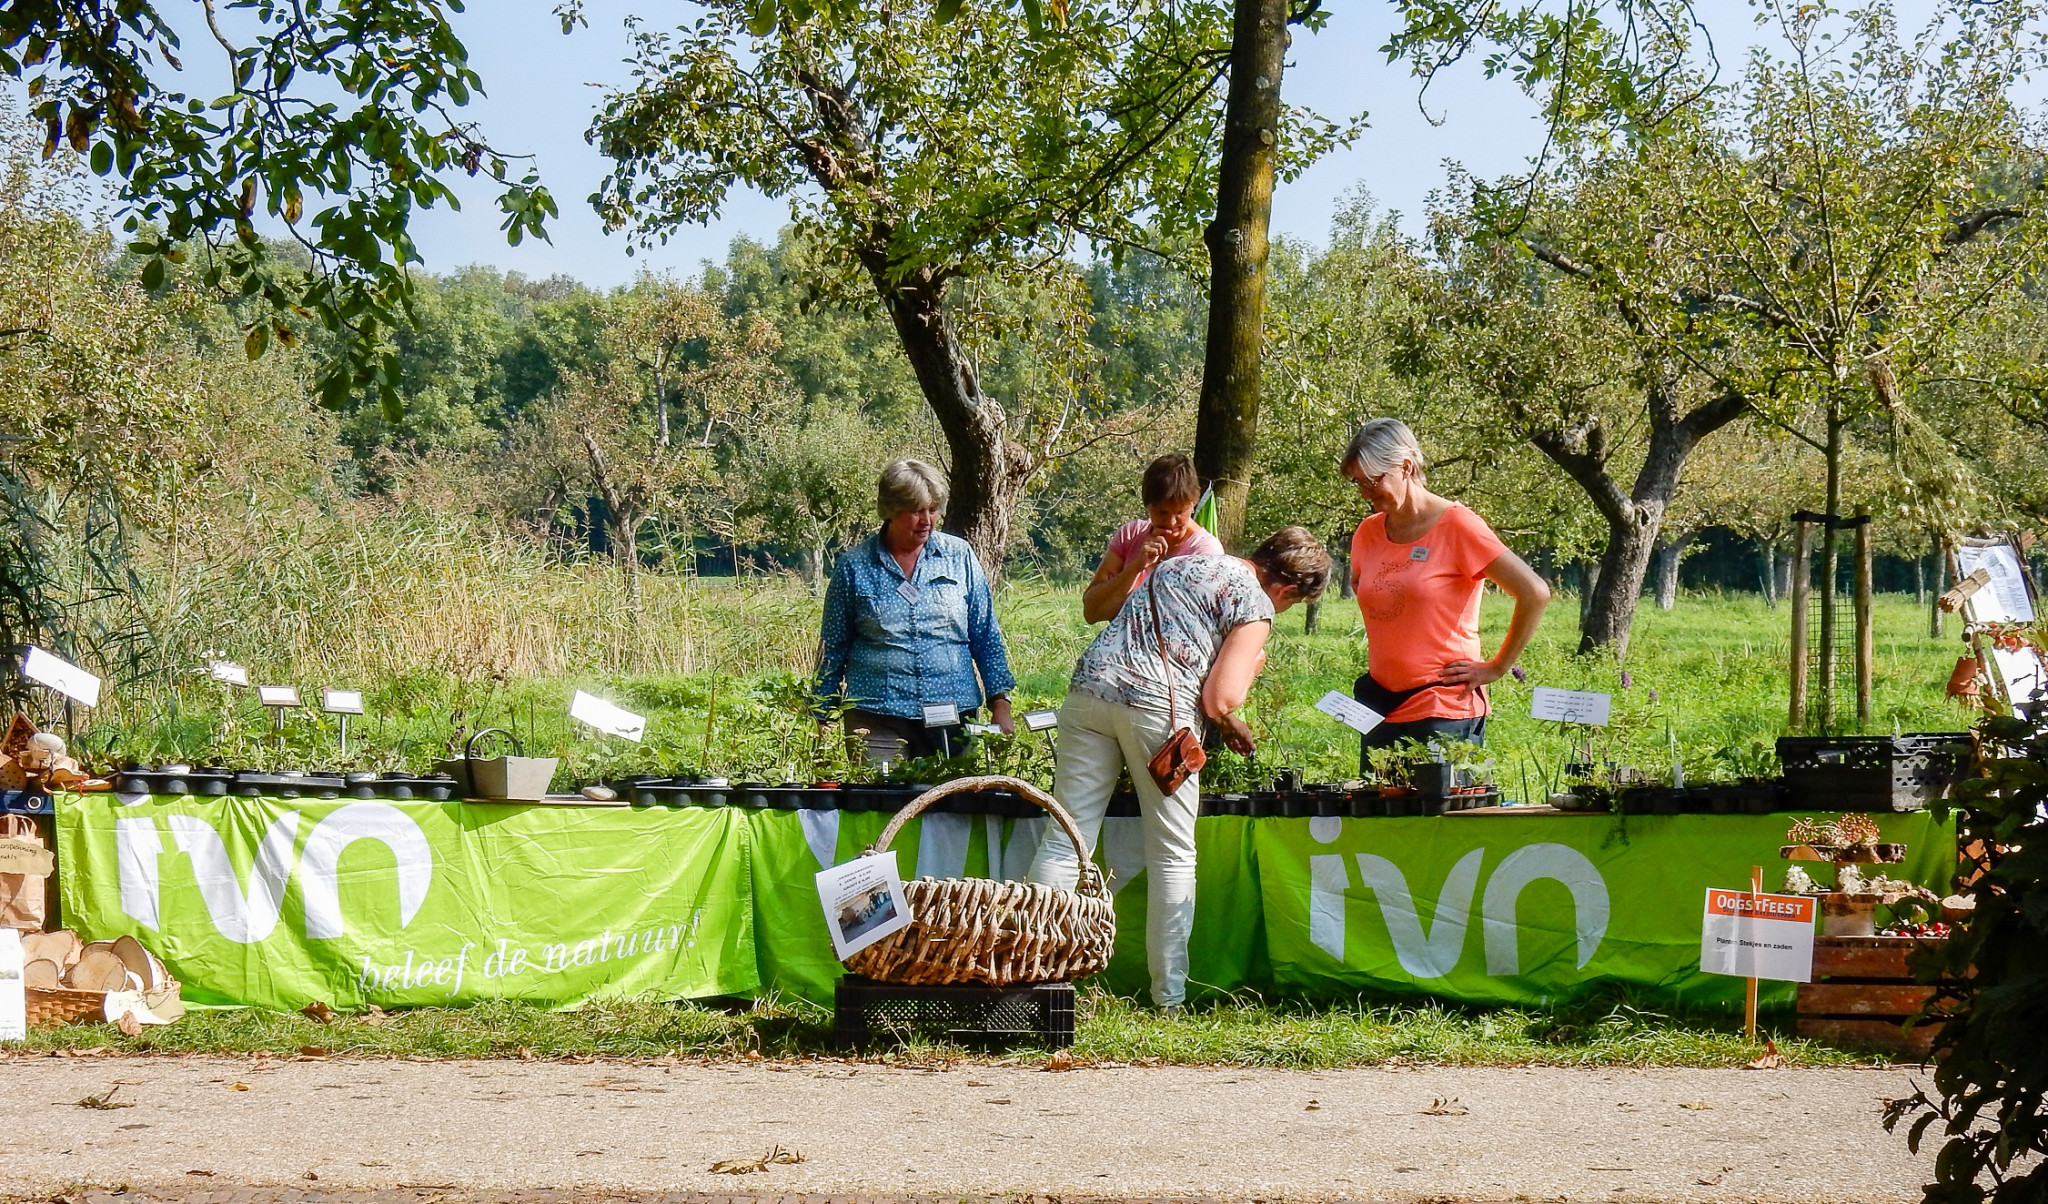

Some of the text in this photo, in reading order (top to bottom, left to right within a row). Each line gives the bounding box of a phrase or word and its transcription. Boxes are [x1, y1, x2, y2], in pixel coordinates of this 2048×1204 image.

[116, 793, 432, 943] ivn
[1309, 816, 1610, 978] ivn
[359, 908, 701, 998] beleef de natuur!
[1716, 937, 1738, 946] Plant
[1739, 939, 1762, 950] Stekjes
[1772, 943, 1793, 951] zaden
